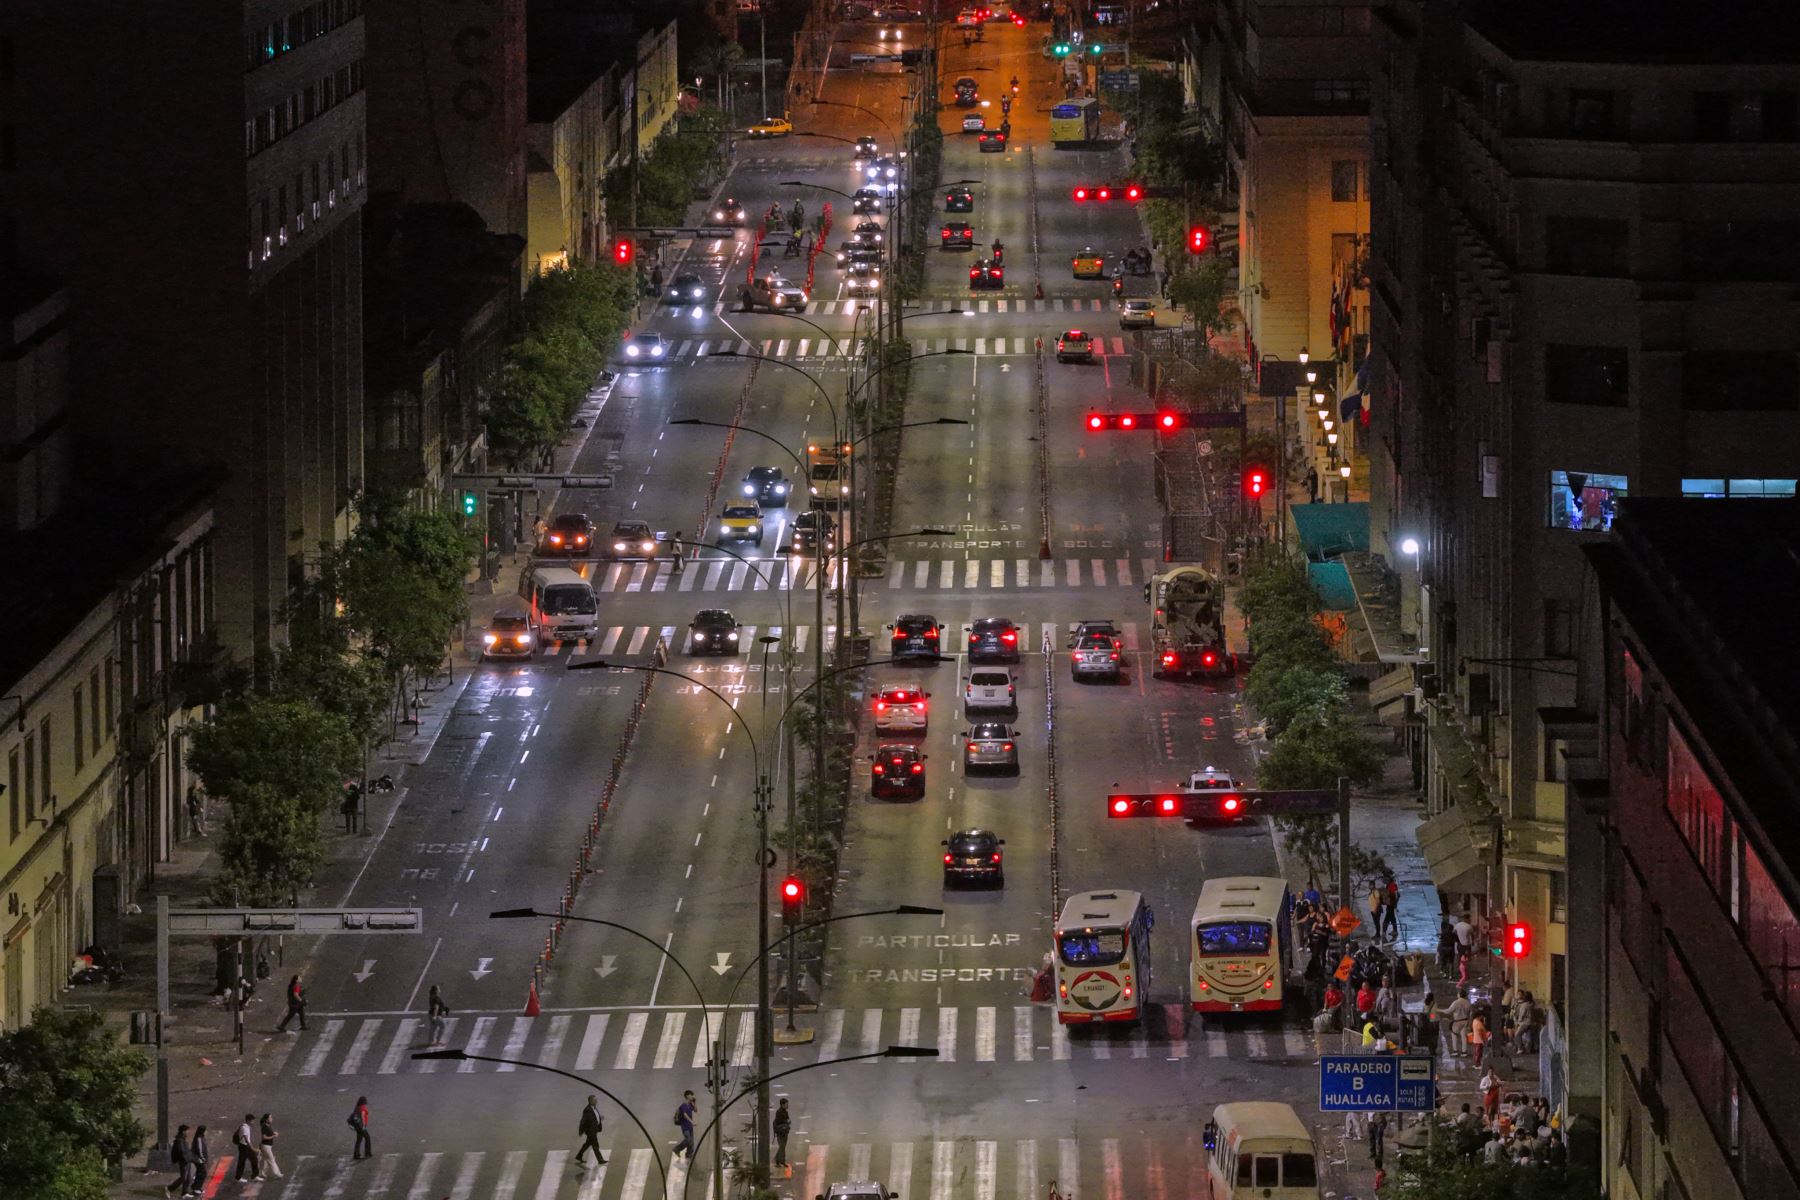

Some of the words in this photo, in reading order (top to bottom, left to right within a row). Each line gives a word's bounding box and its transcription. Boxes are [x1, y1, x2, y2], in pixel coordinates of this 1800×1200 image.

[905, 540, 1026, 549] TRANSPORTE
[857, 933, 1022, 949] PARTICULAR
[1327, 1062, 1391, 1074] PARADERO
[1352, 1076, 1364, 1091] B
[1325, 1094, 1391, 1105] HUALLAGA
